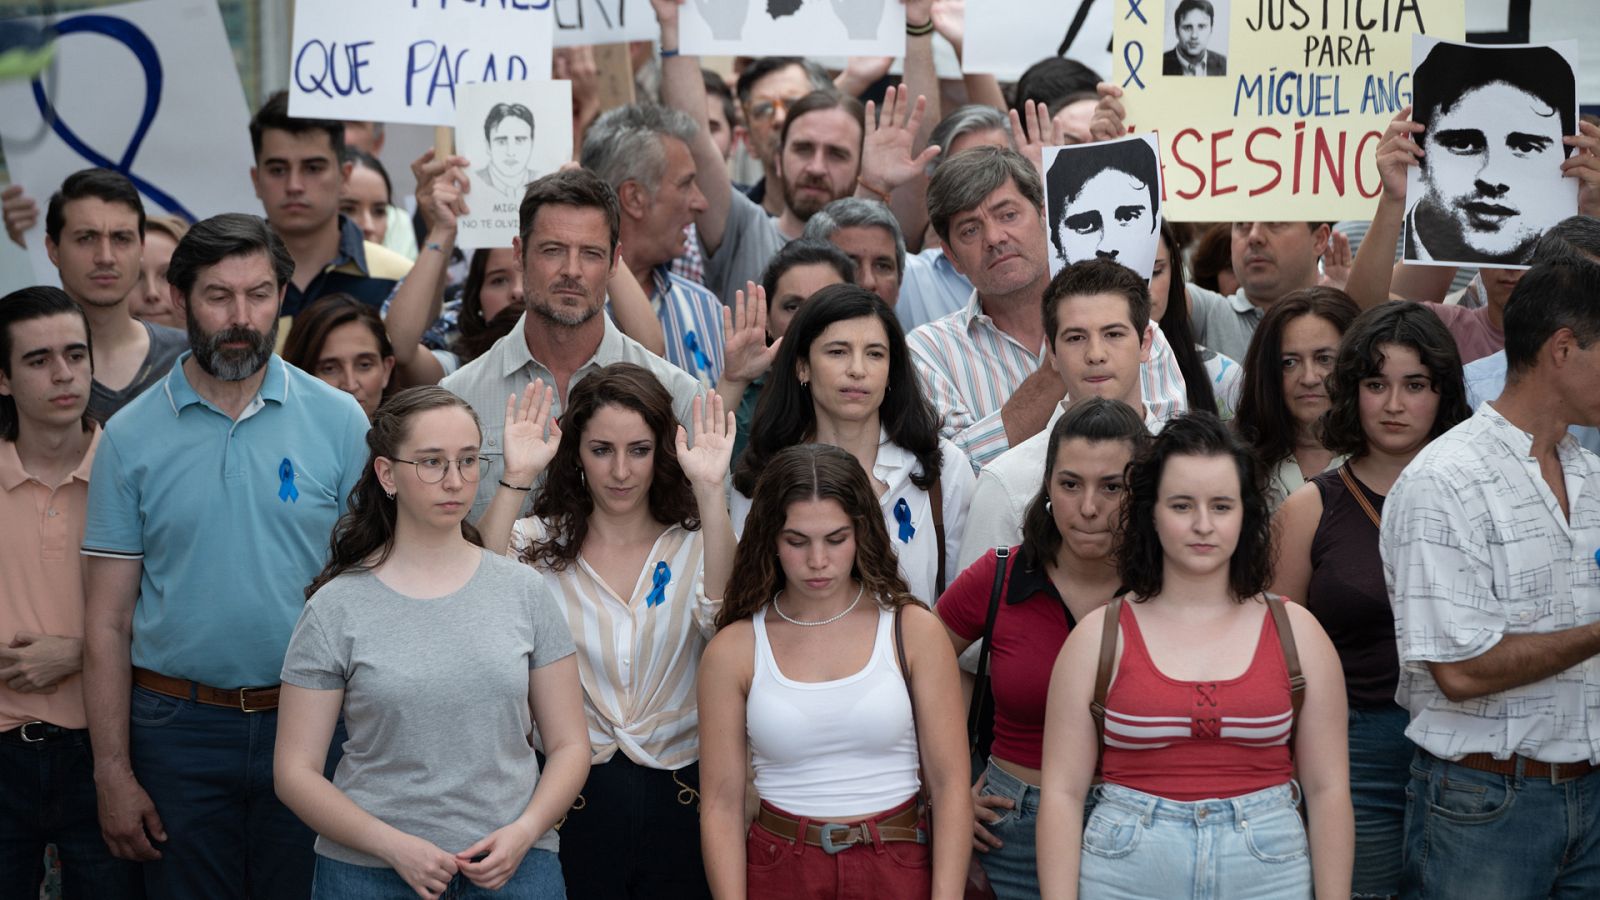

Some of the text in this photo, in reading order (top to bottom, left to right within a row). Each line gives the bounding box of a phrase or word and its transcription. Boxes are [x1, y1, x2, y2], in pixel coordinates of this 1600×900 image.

[294, 39, 374, 99] QUE
[1304, 33, 1375, 67] PARA
[1359, 71, 1412, 115] ANG
[462, 219, 520, 229] NO TE OLVI
